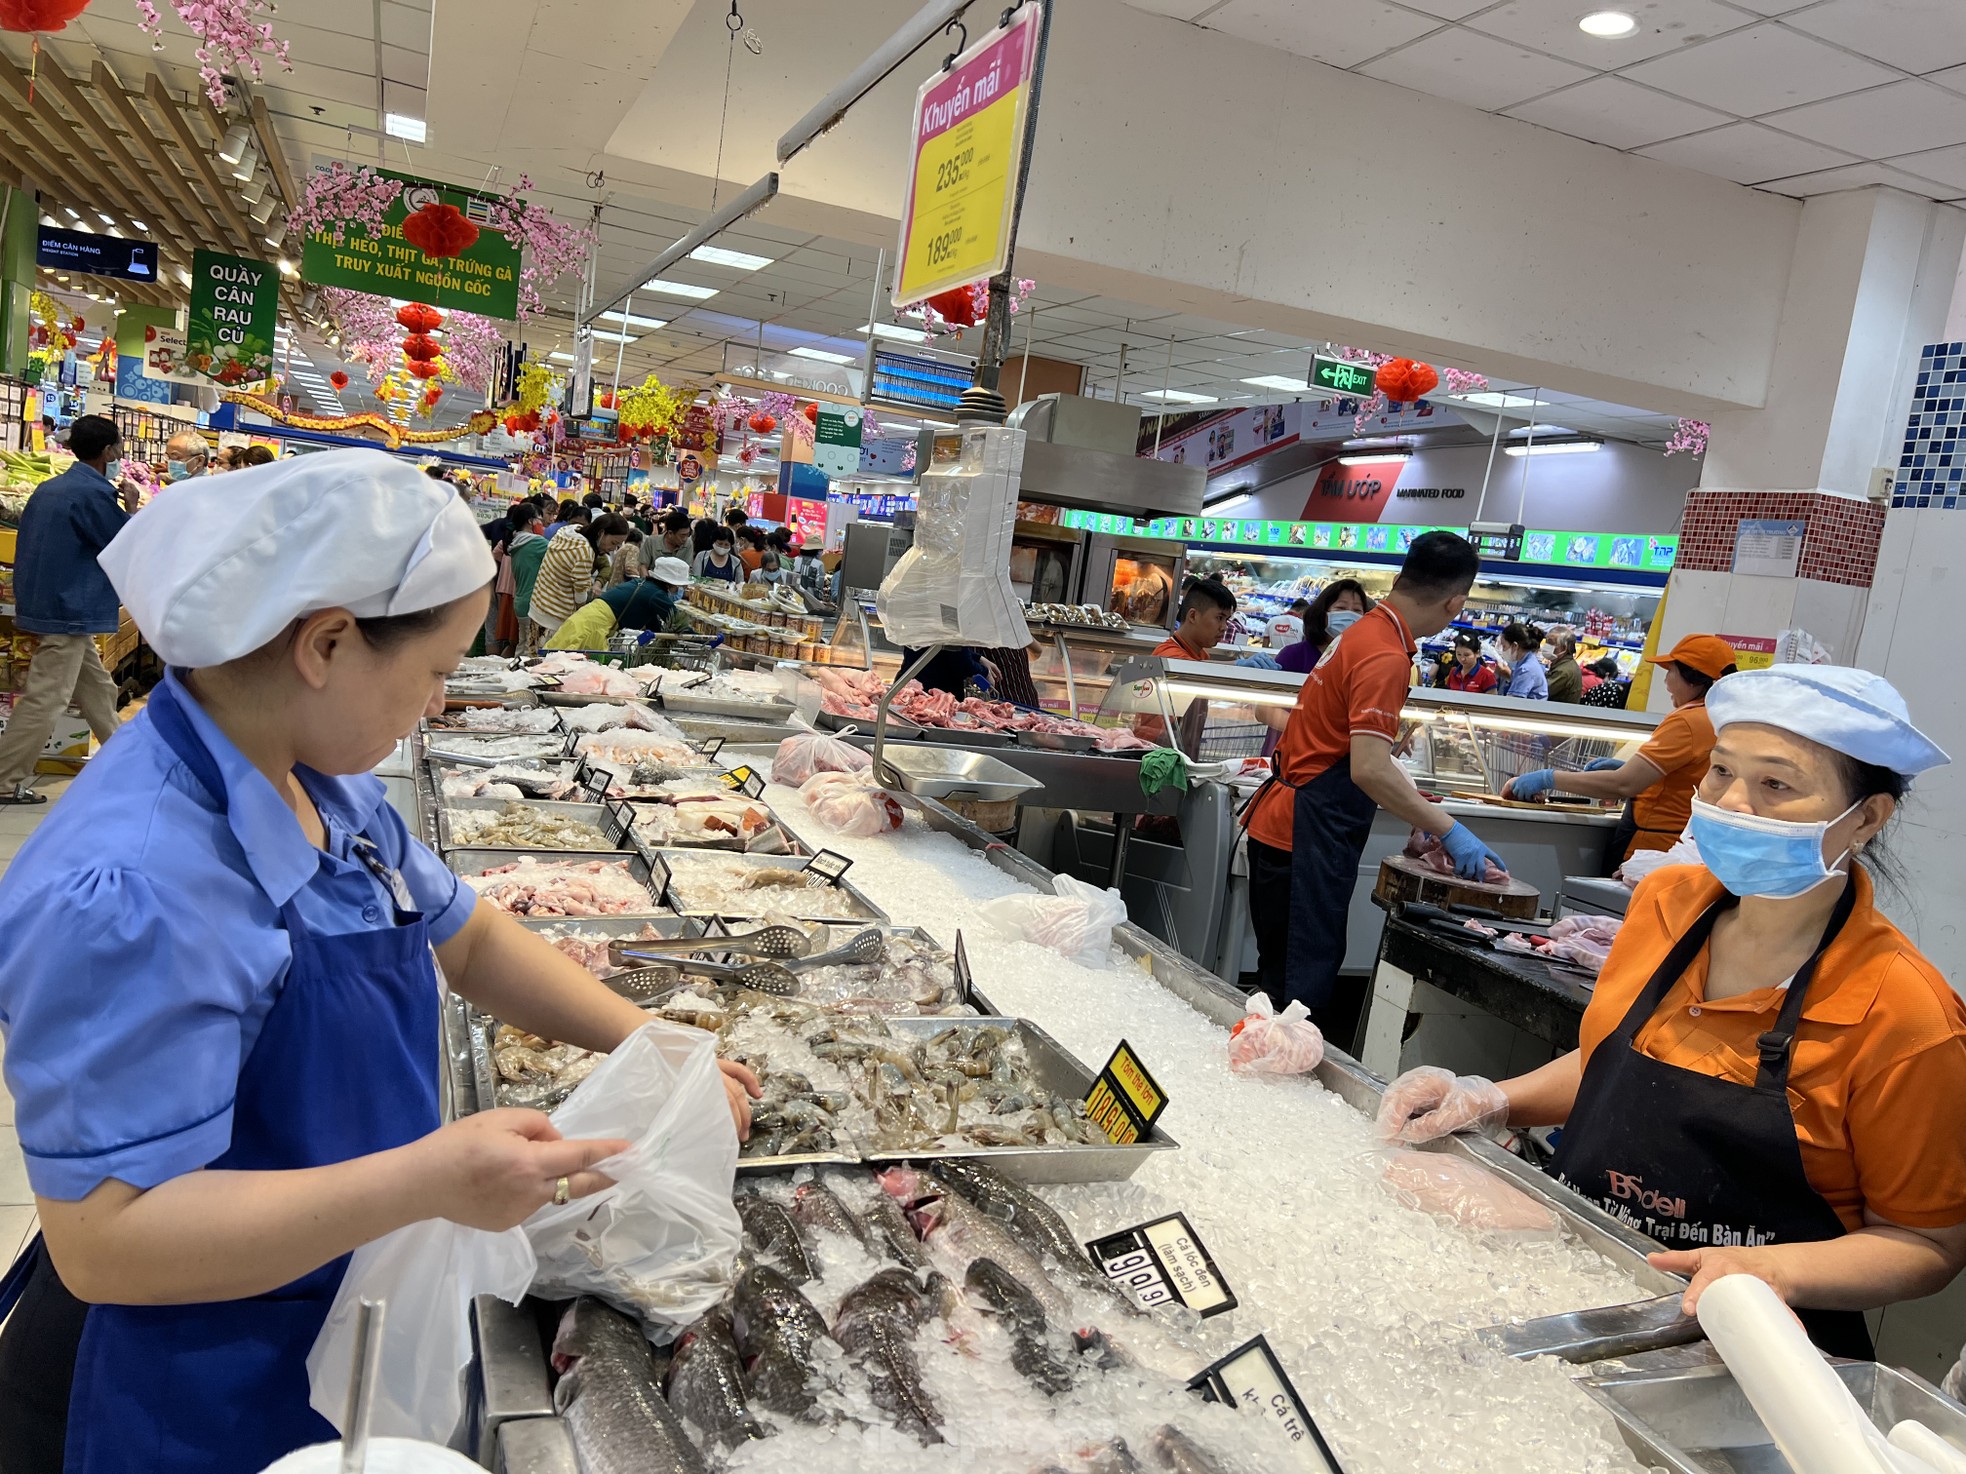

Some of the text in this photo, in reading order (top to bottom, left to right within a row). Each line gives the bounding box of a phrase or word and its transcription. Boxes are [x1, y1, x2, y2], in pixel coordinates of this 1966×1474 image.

[922, 75, 970, 136] Khuyến
[973, 58, 1001, 105] mãi
[350, 237, 382, 257] HEO,
[387, 244, 417, 265] THỊT
[448, 257, 492, 278] TRỨNG
[495, 266, 512, 281] GÀ
[210, 264, 263, 286] QUẦY
[334, 254, 491, 297] TRUY XUẤT NGUỒN GỐC
[214, 286, 254, 306] CÂN
[213, 306, 252, 325] RAU
[217, 327, 245, 344] CỦ
[1352, 373, 1367, 386] EXIT
[1320, 471, 1381, 497] TẨM ƯỚP
[1396, 488, 1465, 499] MARINATED FOOD
[1120, 1056, 1135, 1078] Tôm
[1141, 1085, 1154, 1106] lớn
[1645, 1217, 1675, 1241] Trại
[1679, 1221, 1708, 1243] Đến
[1712, 1224, 1741, 1247] Bàn
[1158, 1243, 1196, 1293] (làm sạch)
[1176, 1237, 1211, 1288] Cá lóc đen
[1271, 1394, 1305, 1442] Cá trê
